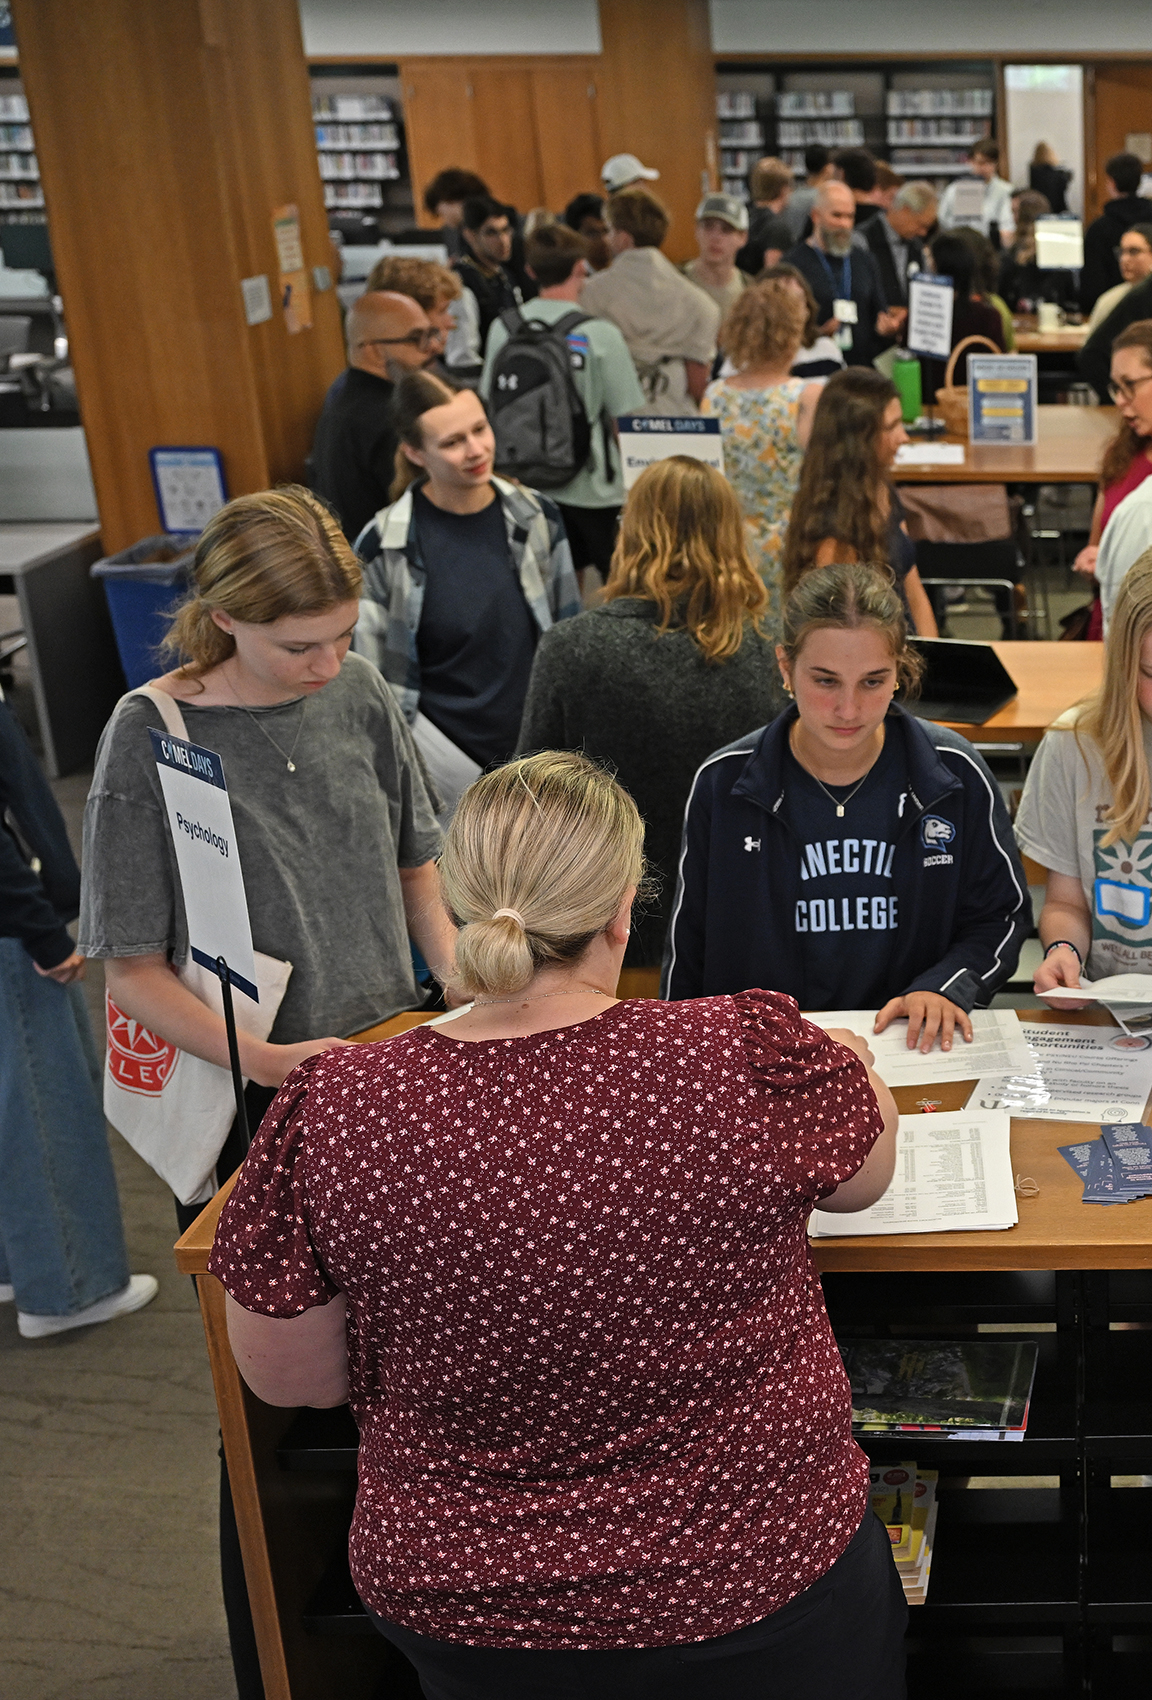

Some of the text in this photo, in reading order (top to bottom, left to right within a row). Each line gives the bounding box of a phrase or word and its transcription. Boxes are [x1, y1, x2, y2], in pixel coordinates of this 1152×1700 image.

[673, 419, 706, 432] DAYS
[190, 751, 214, 778] DAYS
[176, 812, 230, 858] Psychology
[923, 854, 954, 868] SOCCER
[795, 896, 899, 933] COLLEGE
[1122, 950, 1138, 960] ALL
[1024, 1035, 1096, 1044] ngagement
[1027, 1042, 1104, 1050] portunities
